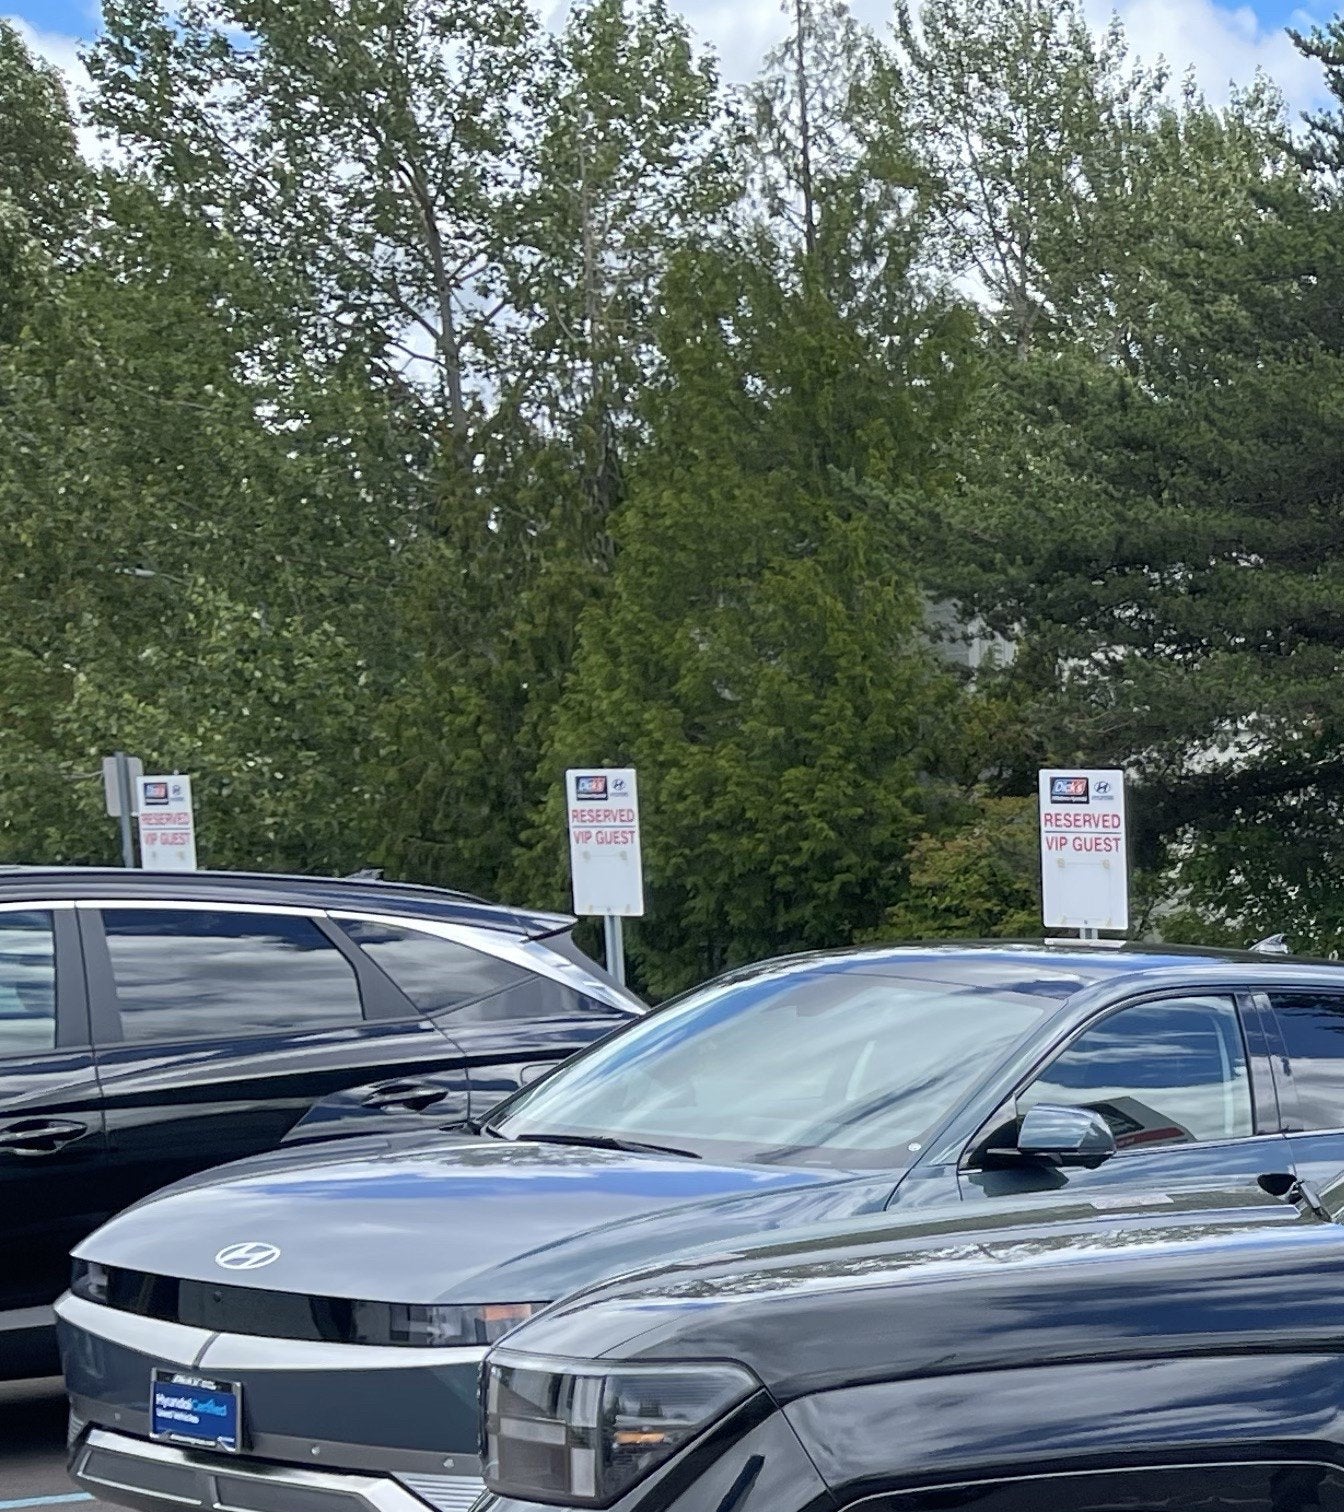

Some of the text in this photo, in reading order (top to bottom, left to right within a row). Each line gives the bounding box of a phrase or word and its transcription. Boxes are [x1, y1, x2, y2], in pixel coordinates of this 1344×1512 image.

[571, 809, 635, 823] RESERVED
[1044, 813, 1121, 829] RESERVED
[573, 831, 635, 845] VIP GUEST
[1046, 837, 1121, 852] VIP GUEST
